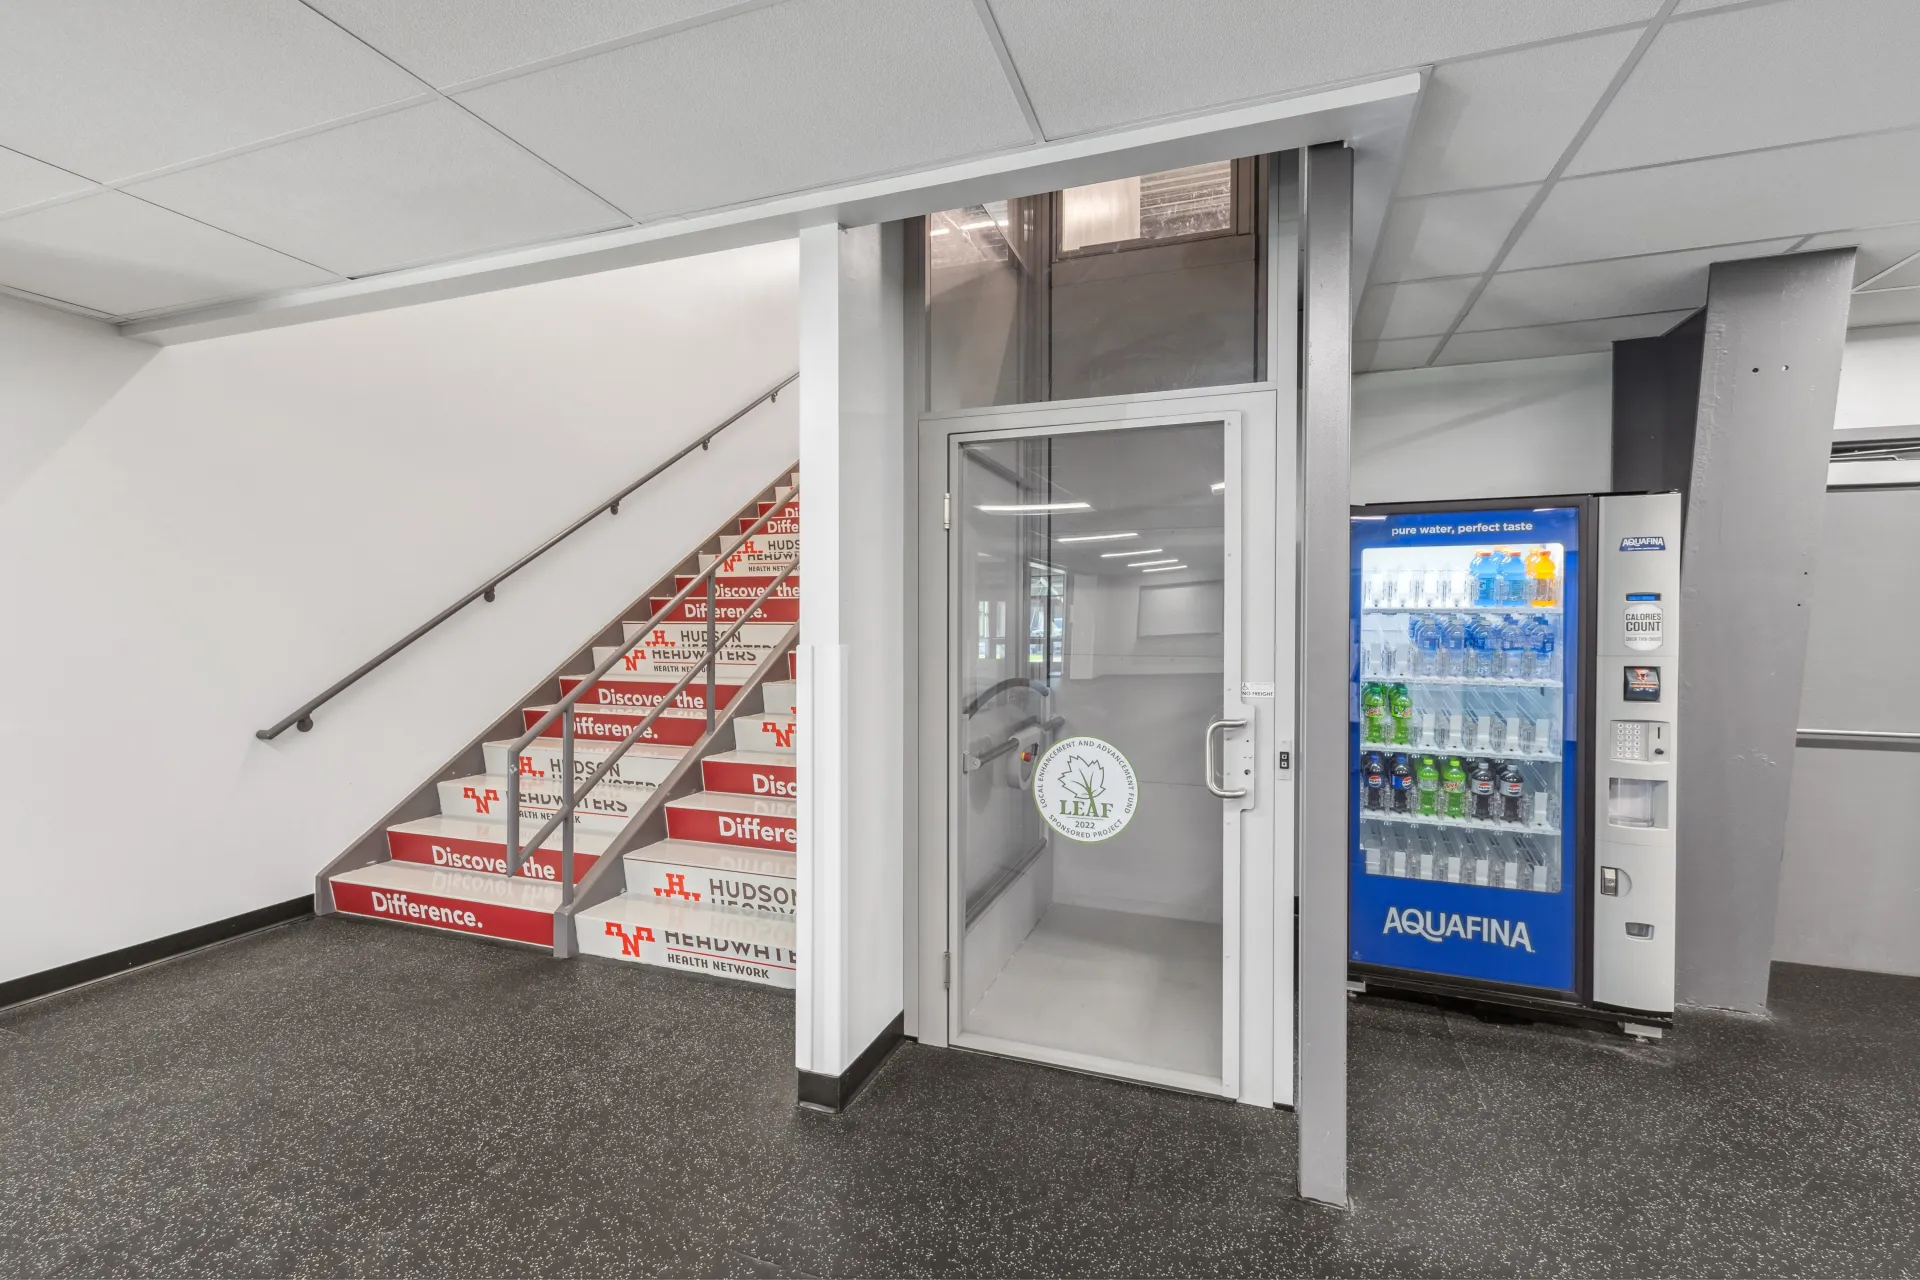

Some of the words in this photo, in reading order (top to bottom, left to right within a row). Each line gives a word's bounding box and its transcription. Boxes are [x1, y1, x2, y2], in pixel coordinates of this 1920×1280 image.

[1391, 526, 1417, 536] pure
[1420, 525, 1455, 535] water,
[1457, 522, 1500, 534] perfect
[1503, 521, 1533, 532] taste
[768, 540, 799, 551] HUDS
[1622, 537, 1664, 547] AQUAFINA
[714, 583, 768, 598] Discove
[776, 582, 800, 598] the
[684, 603, 768, 619] Diferene.
[1625, 613, 1662, 621] CALORIES
[1625, 621, 1662, 632] COUNT
[653, 665, 679, 673] HEALTH
[598, 688, 668, 707] Discove
[675, 690, 704, 709] the
[573, 716, 658, 739] ifferene.
[1078, 740, 1095, 748] AND
[550, 758, 621, 777] HDSON
[1037, 740, 1076, 782] ENHANCEMENT
[1096, 743, 1135, 791] ADVANCEMENT
[1037, 784, 1048, 809] LOCAL
[1124, 792, 1135, 814] FUND
[1059, 799, 1114, 819] LEAF
[719, 815, 797, 844] Differe
[1048, 814, 1091, 838] SPONSORED
[1093, 818, 1123, 838] PROJECT
[1074, 820, 1096, 830] 2022
[432, 845, 508, 874] Discove
[523, 856, 556, 880] the
[709, 878, 797, 905] HUDSO
[371, 891, 484, 929] Difference.
[1383, 906, 1535, 953] AQUAFINA
[667, 953, 709, 969] HEALTH
[713, 960, 770, 980] NETWORK
